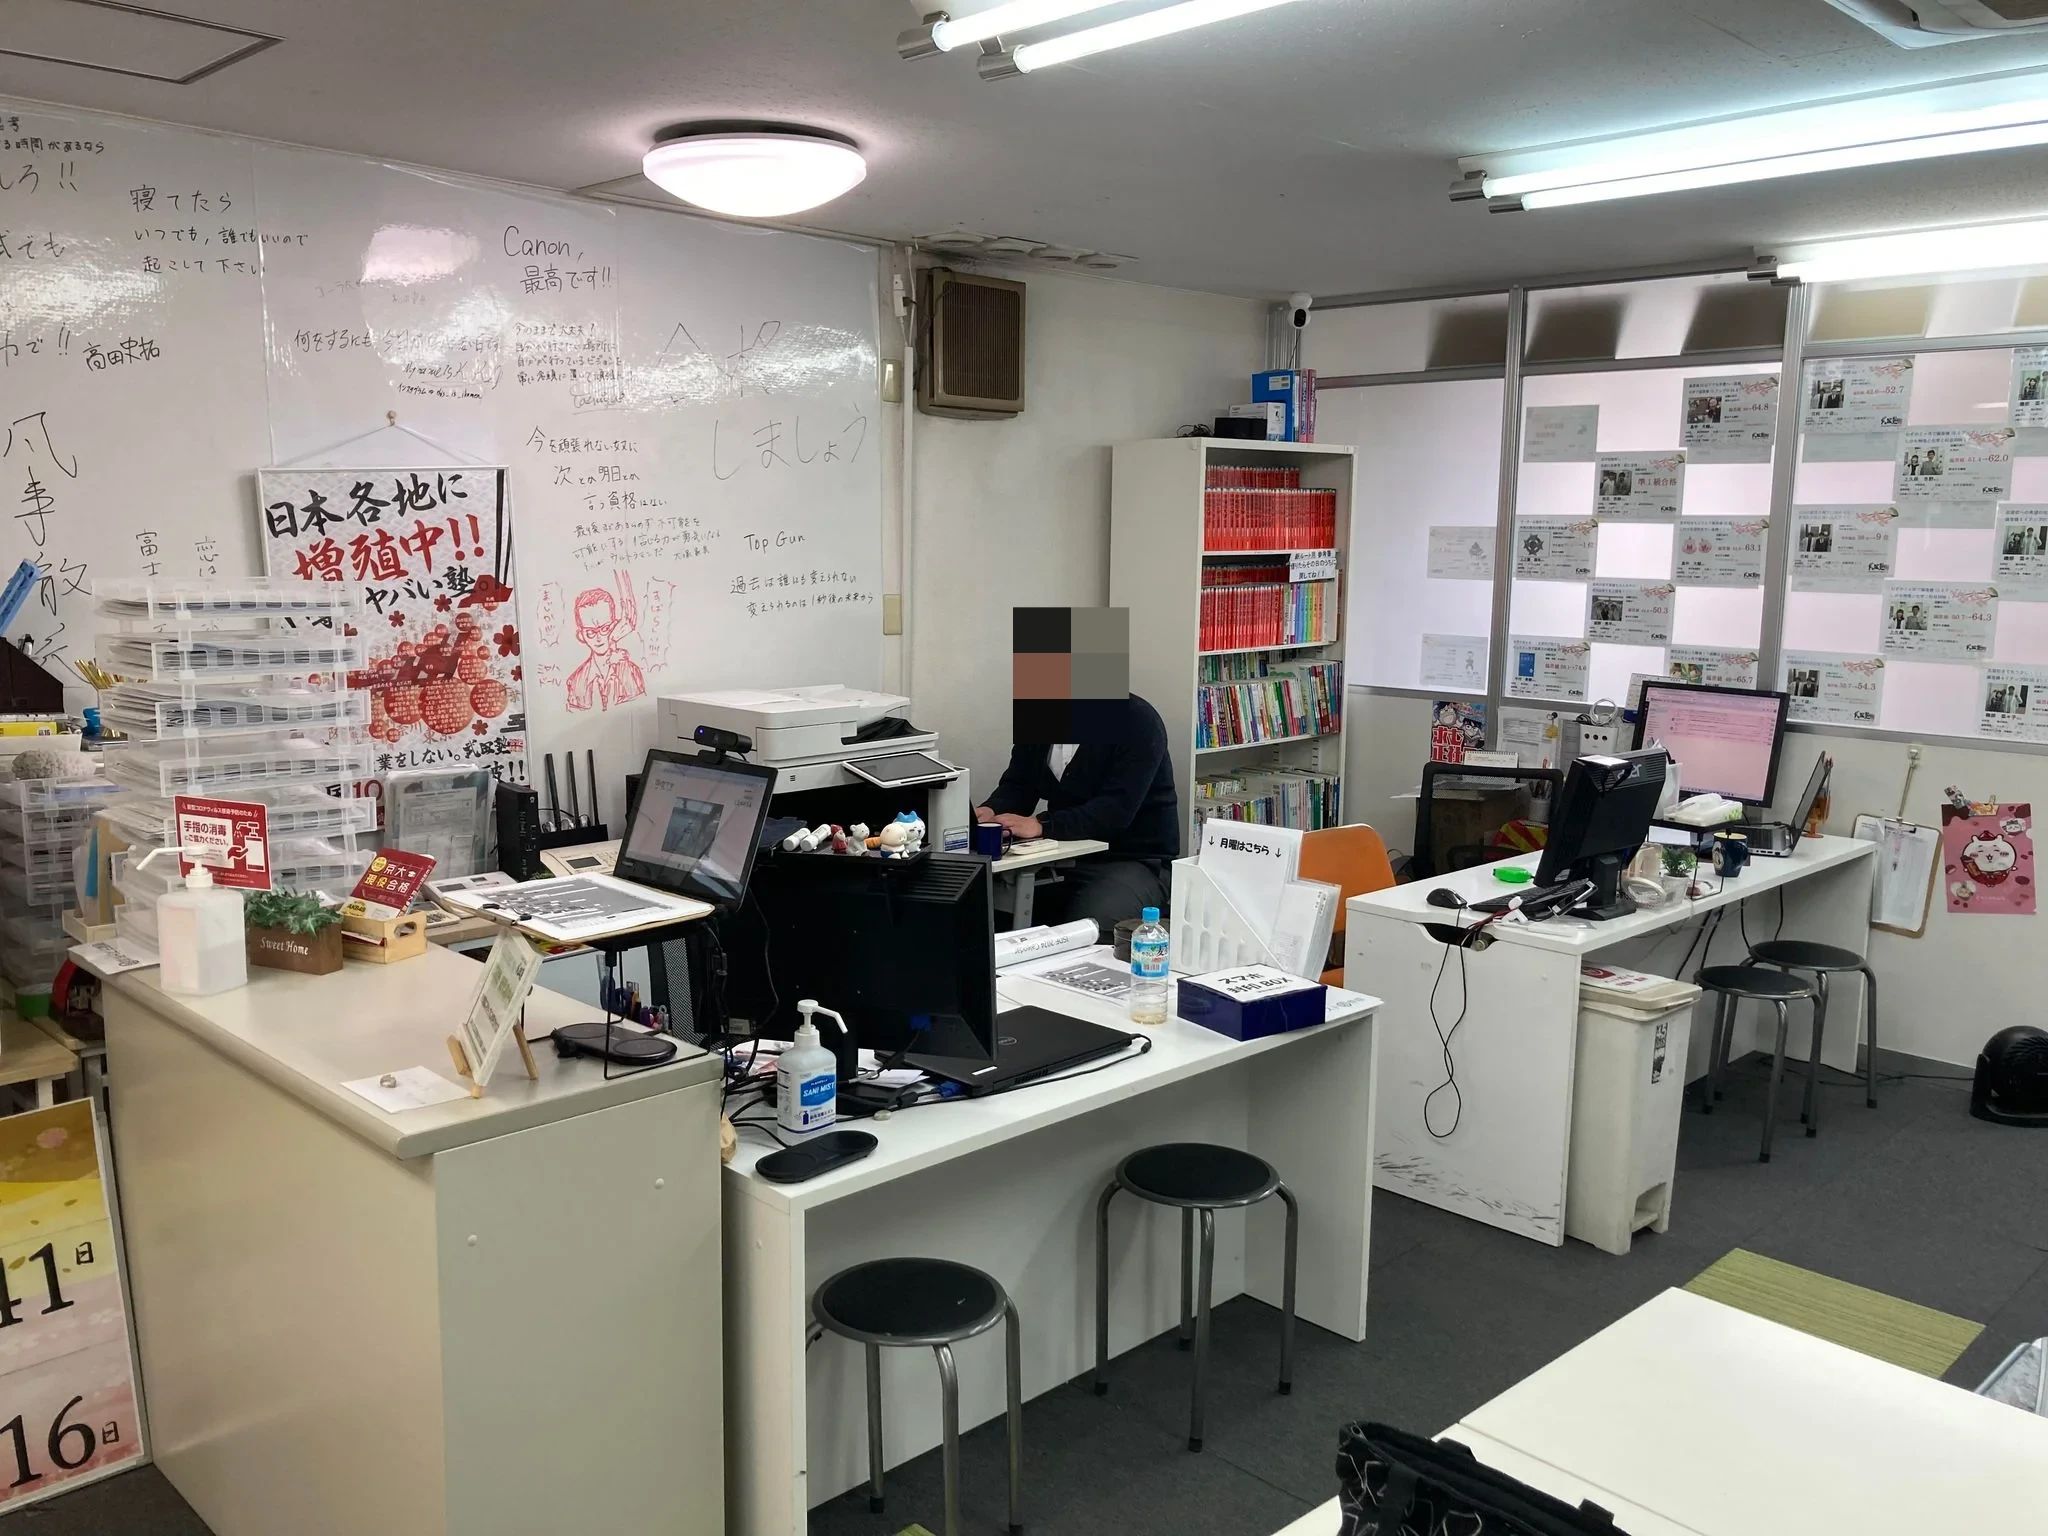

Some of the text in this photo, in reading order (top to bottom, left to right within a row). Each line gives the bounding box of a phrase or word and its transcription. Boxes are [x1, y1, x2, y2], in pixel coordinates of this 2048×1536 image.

[4, 137, 105, 155] る時間があるなら
[130, 184, 232, 213] 寝てたら
[143, 255, 266, 275] 起こして下さい
[713, 402, 868, 480] しましょう
[264, 472, 470, 539] 日本各地に
[744, 530, 806, 554] Top Gun
[365, 565, 477, 615] ヤバい塾
[183, 820, 227, 837] 手指の消毒
[1219, 837, 1270, 856] 月曜はこちら
[383, 863, 407, 878] 京大
[364, 873, 411, 894] 現役合格
[260, 936, 309, 956] Sweet Home
[1217, 972, 1265, 985] スマホ
[1260, 976, 1294, 987] BOX
[803, 1082, 835, 1098] SANI MIST
